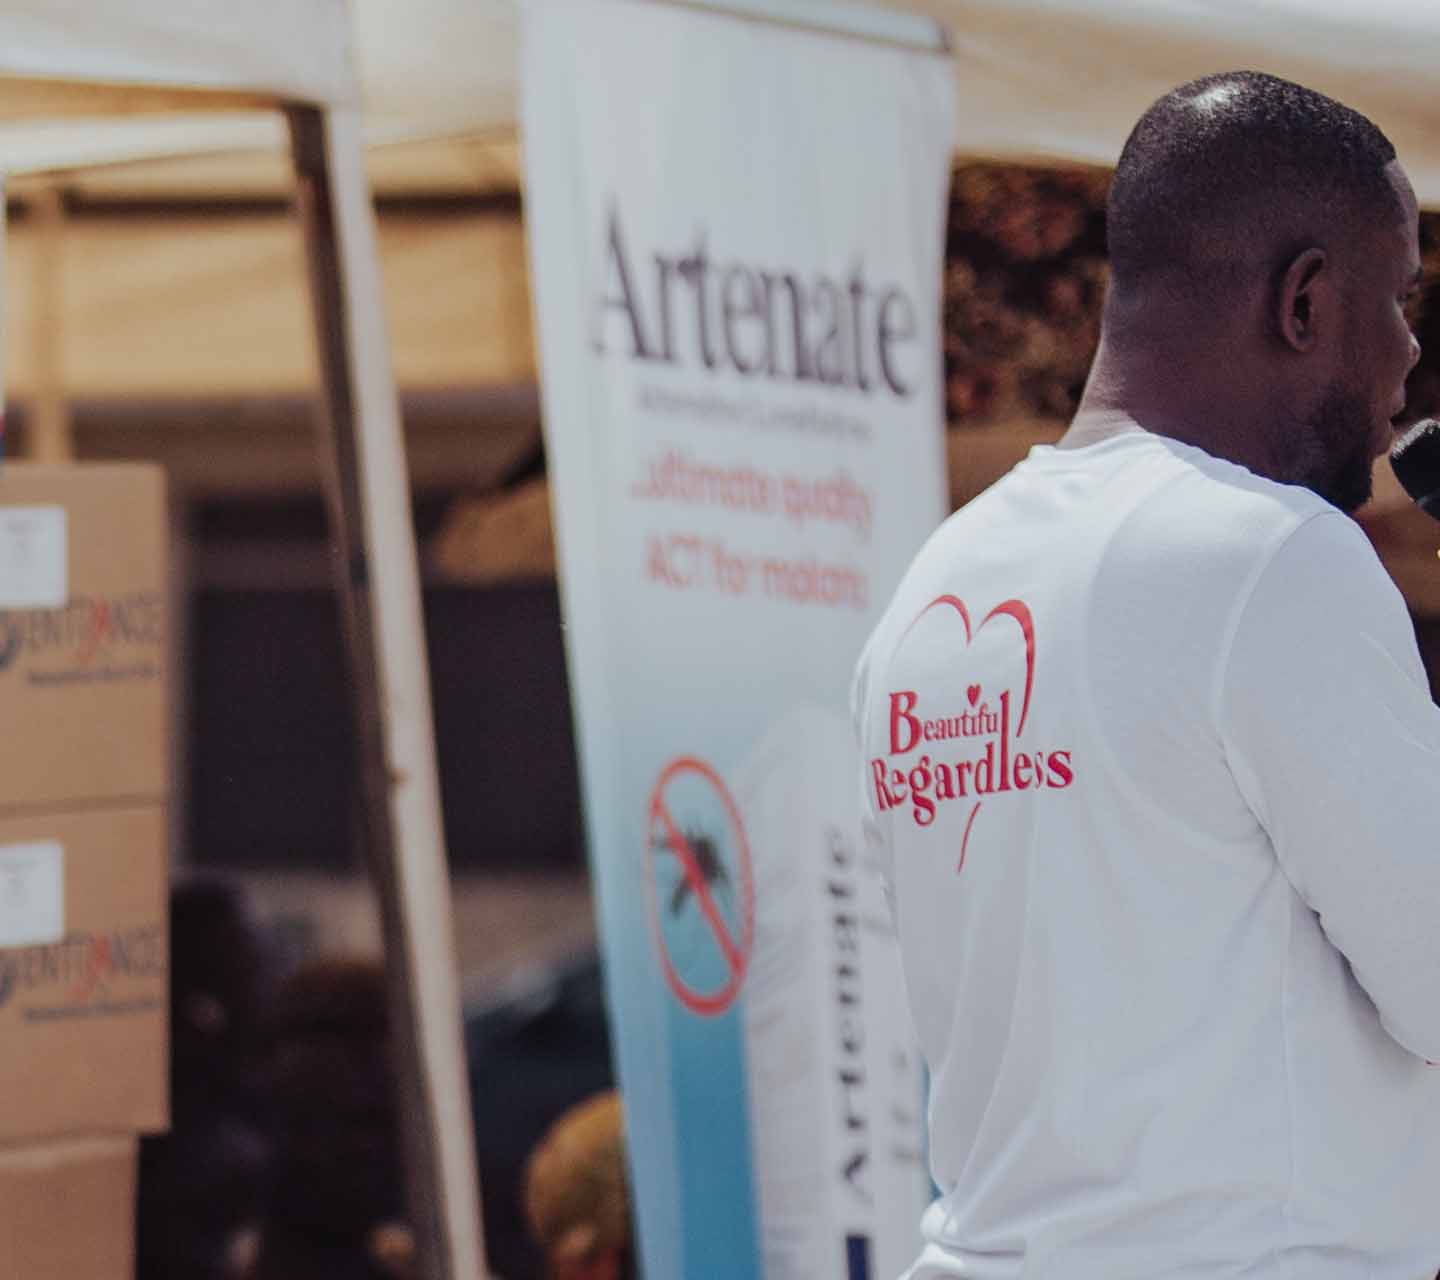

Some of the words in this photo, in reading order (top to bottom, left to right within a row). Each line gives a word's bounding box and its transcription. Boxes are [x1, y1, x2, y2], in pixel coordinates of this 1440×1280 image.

[588, 195, 916, 398] Artenate
[889, 690, 1011, 758] Beautiful
[872, 742, 1074, 827] Regardless
